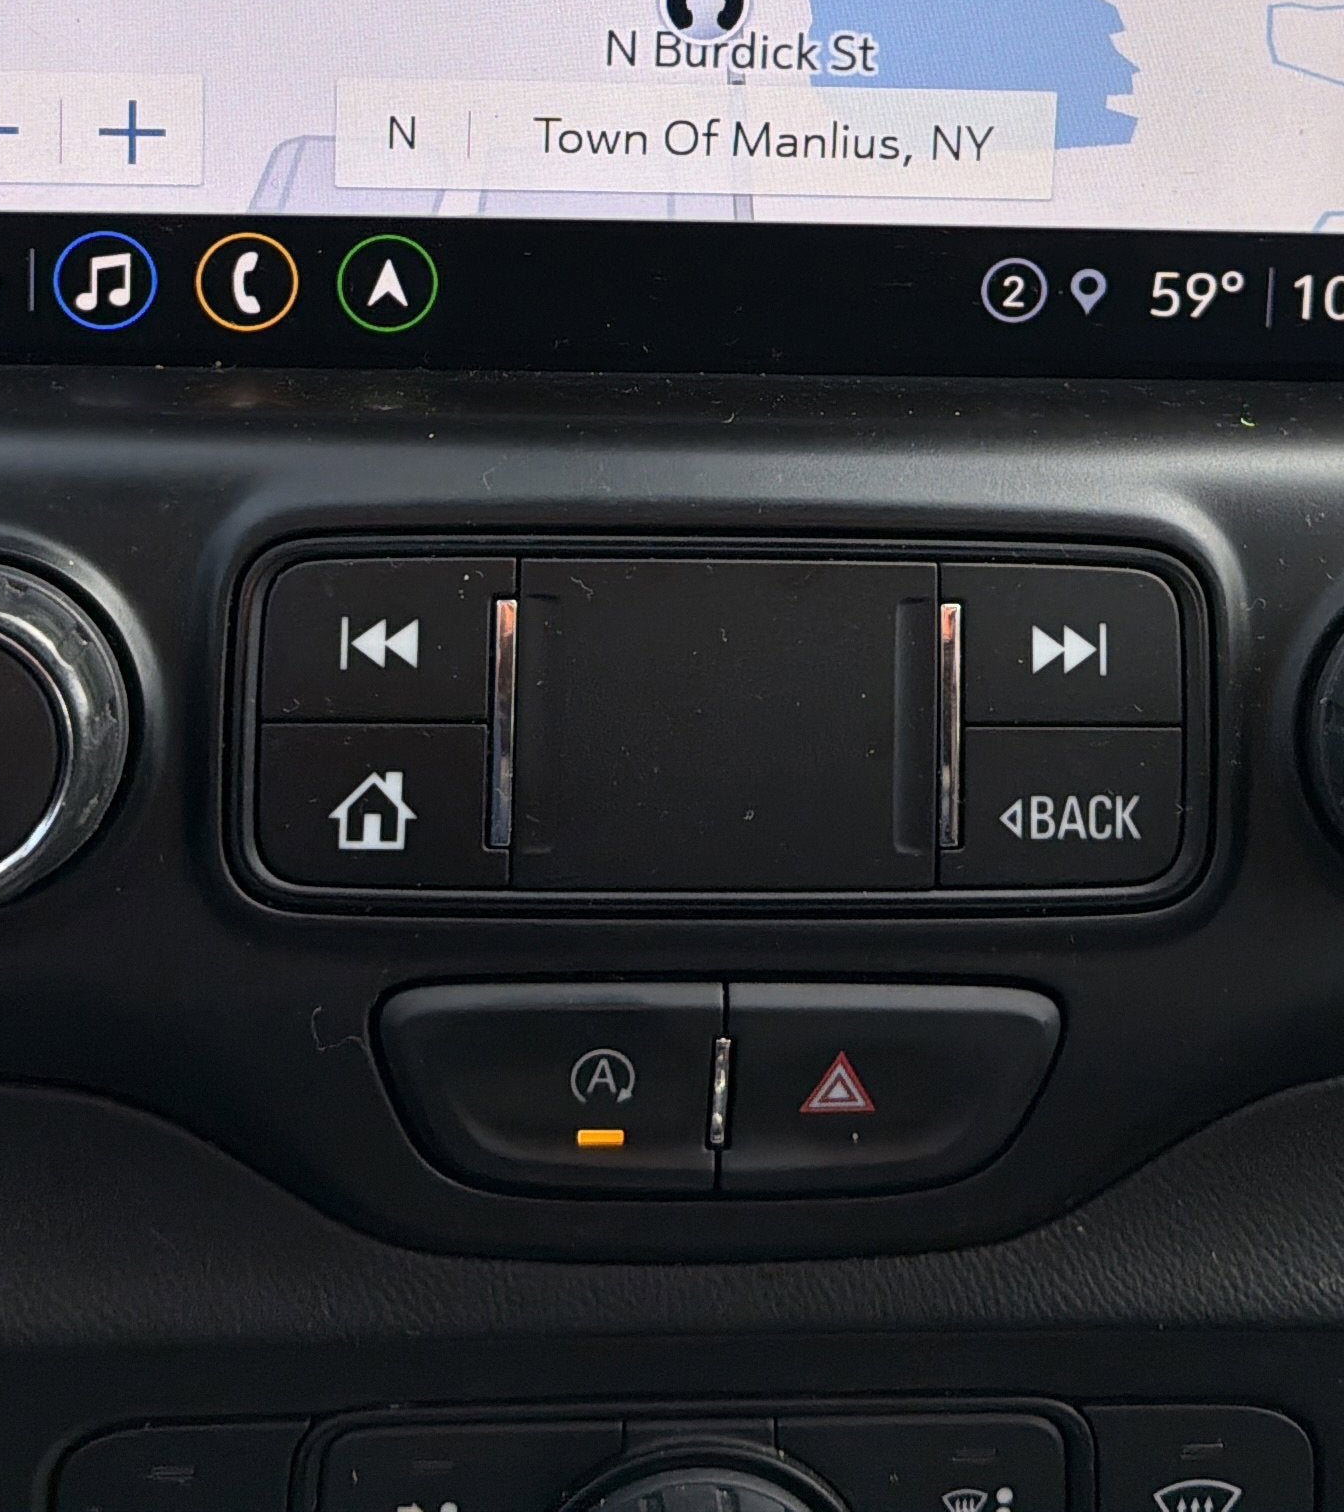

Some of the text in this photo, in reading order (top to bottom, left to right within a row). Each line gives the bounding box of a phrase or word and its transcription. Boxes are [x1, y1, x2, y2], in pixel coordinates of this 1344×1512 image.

[605, 29, 876, 72] N Burdick St
[388, 115, 416, 150] N
[532, 116, 995, 168] Town Of Manlius, NY
[1001, 274, 1026, 308] 2
[1149, 270, 1246, 319] 59°
[1029, 794, 1143, 840] BACK
[586, 1057, 617, 1093] A
